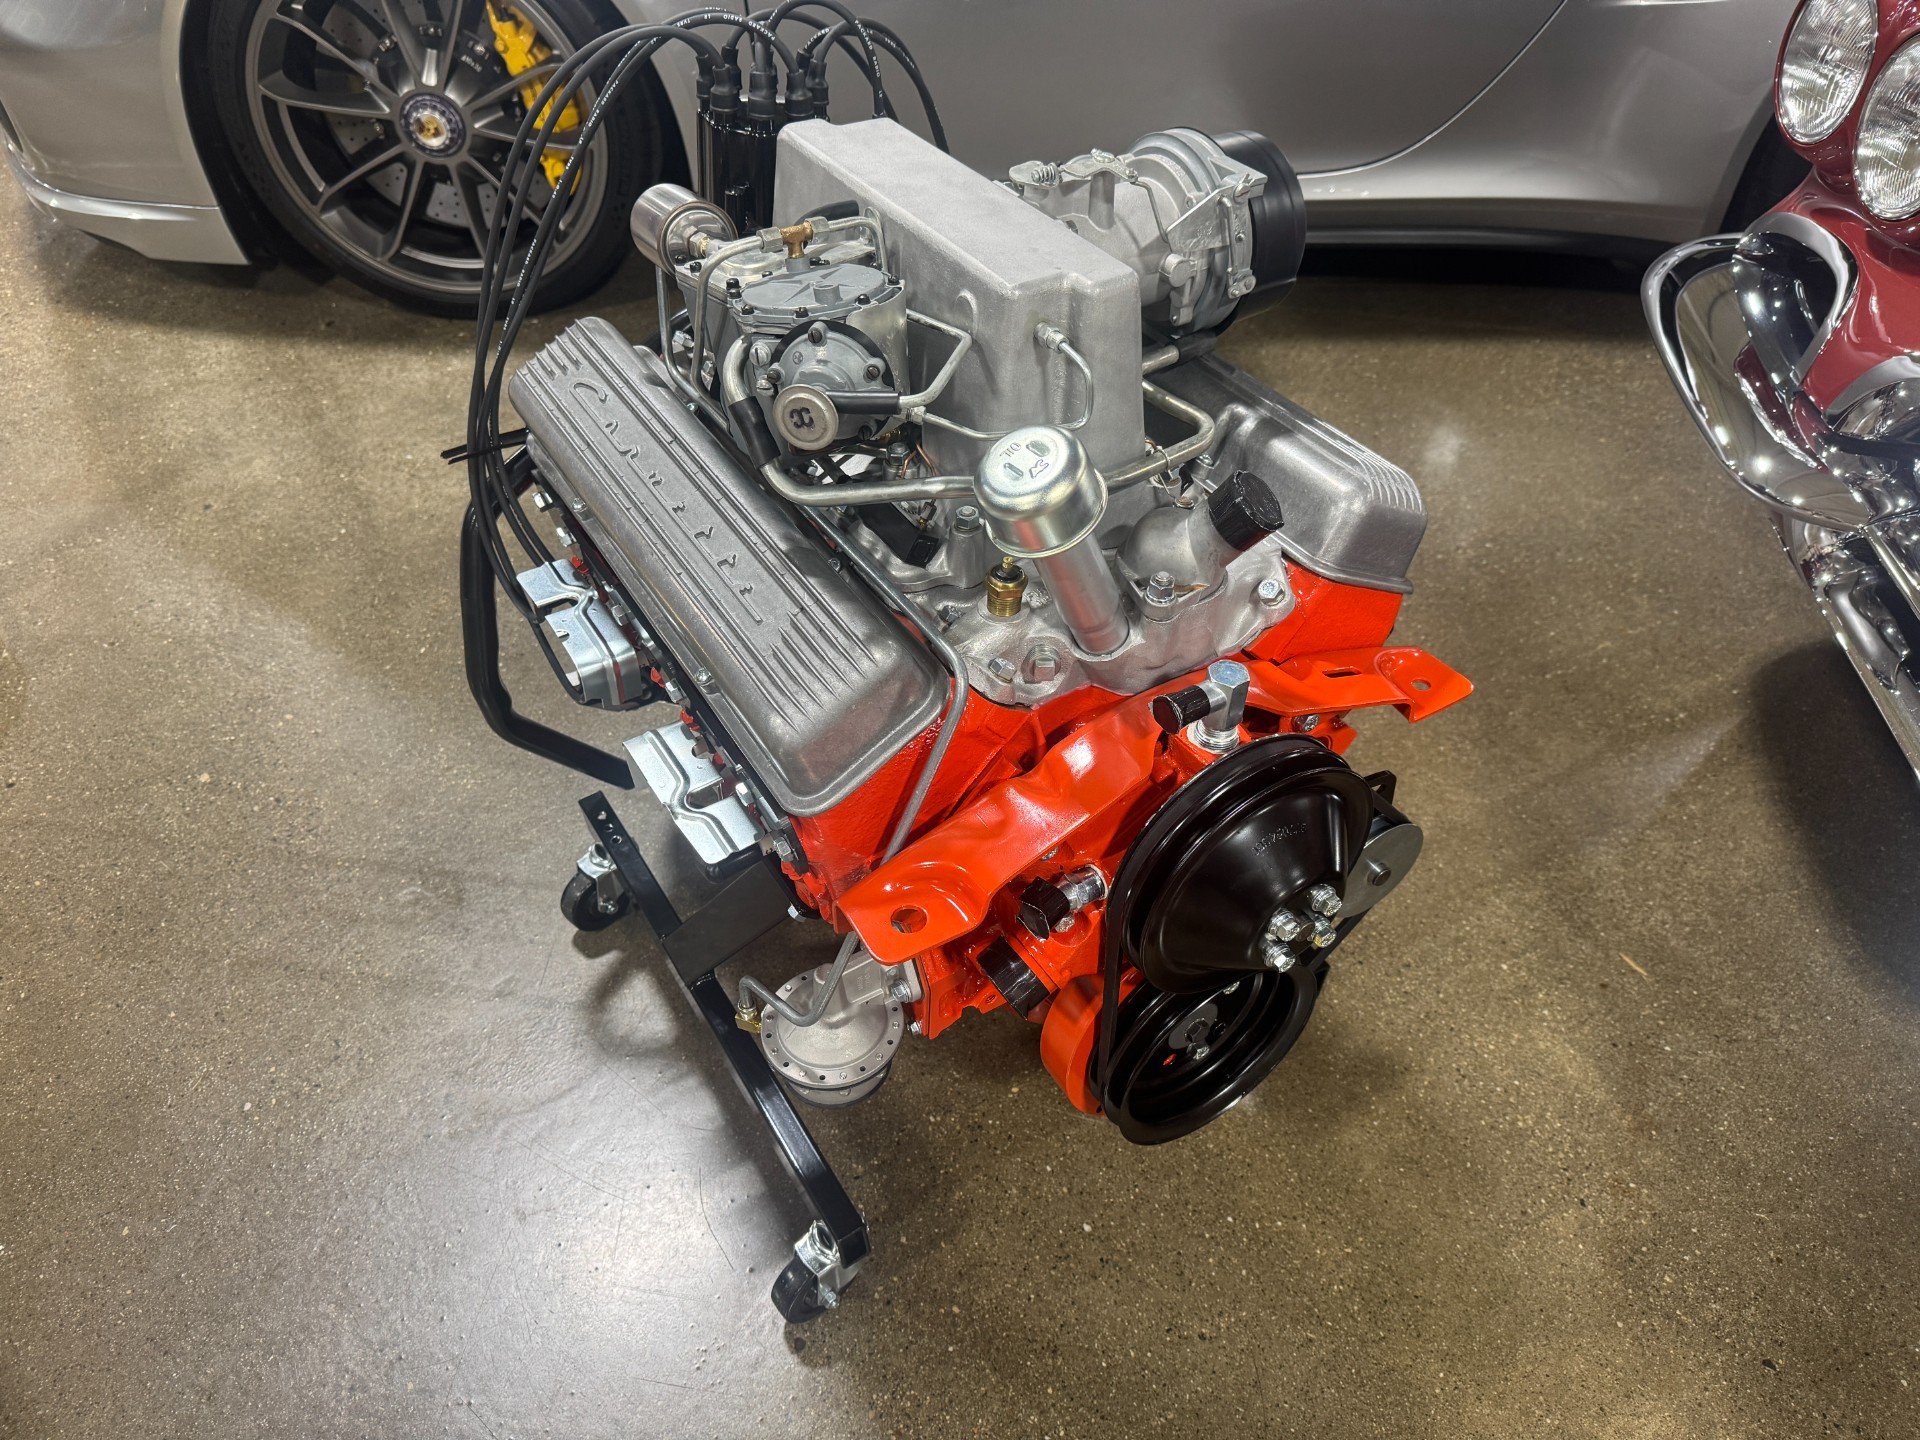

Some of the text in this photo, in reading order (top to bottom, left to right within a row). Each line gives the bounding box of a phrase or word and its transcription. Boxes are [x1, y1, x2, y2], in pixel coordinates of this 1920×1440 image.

[722, 13, 744, 23] RADIO
[748, 20, 777, 41] PACKARD
[854, 19, 874, 51] PACKARD
[872, 55, 881, 78] RADIO
[600, 79, 619, 106] PACKARD
[587, 108, 600, 127] RADIO
[999, 442, 1022, 458] OIL
